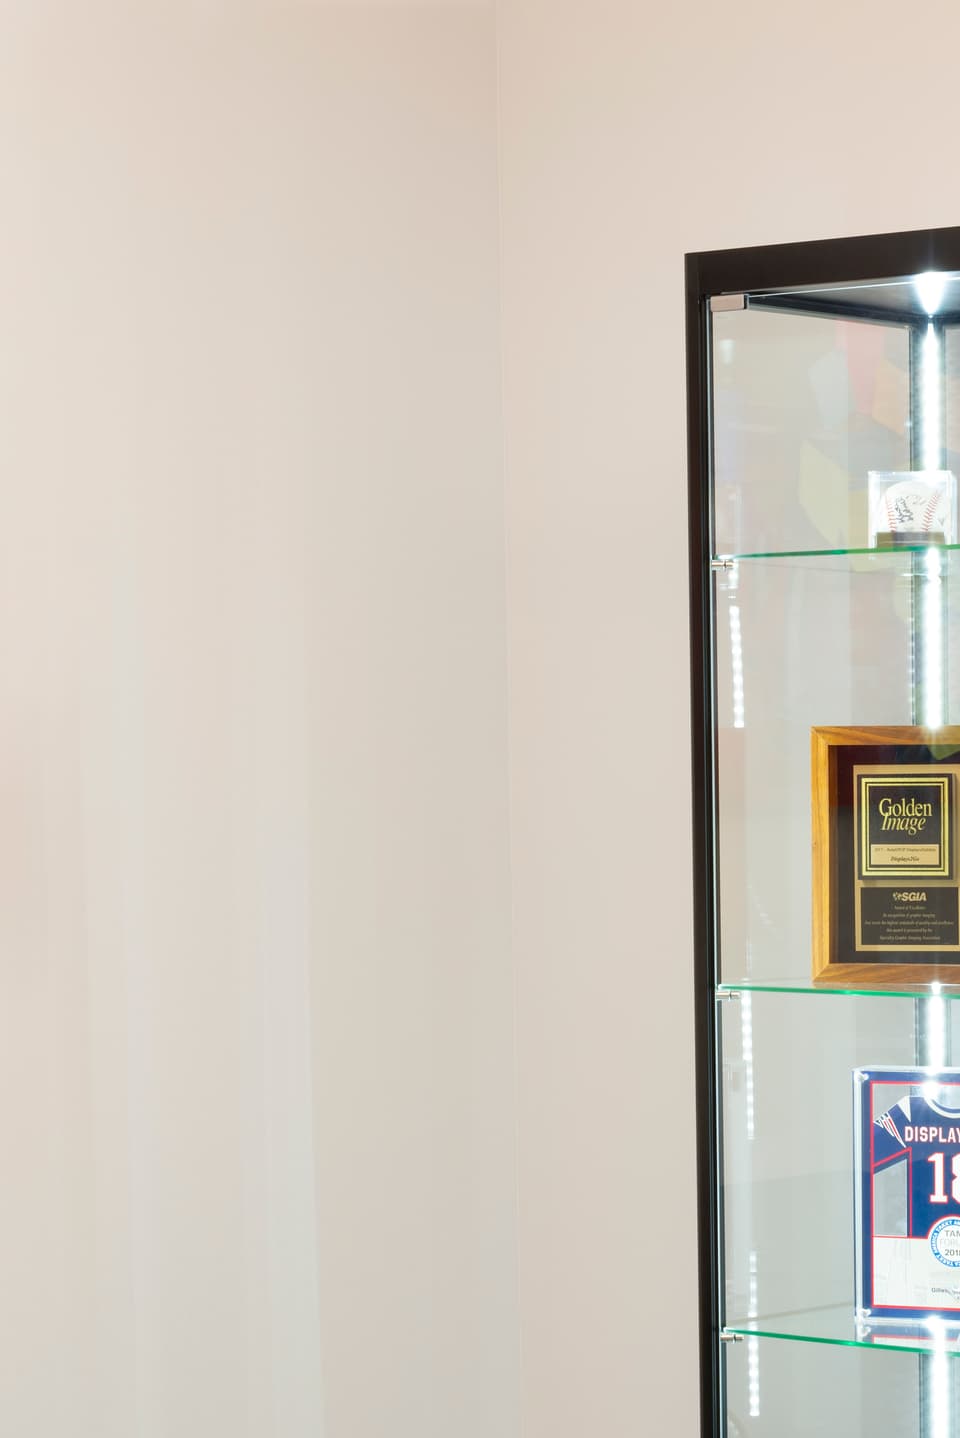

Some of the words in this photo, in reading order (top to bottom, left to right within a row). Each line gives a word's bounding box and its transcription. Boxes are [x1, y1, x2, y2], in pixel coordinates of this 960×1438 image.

[878, 797, 933, 817] Golden
[880, 812, 927, 836] Image
[902, 891, 927, 902] SGIA
